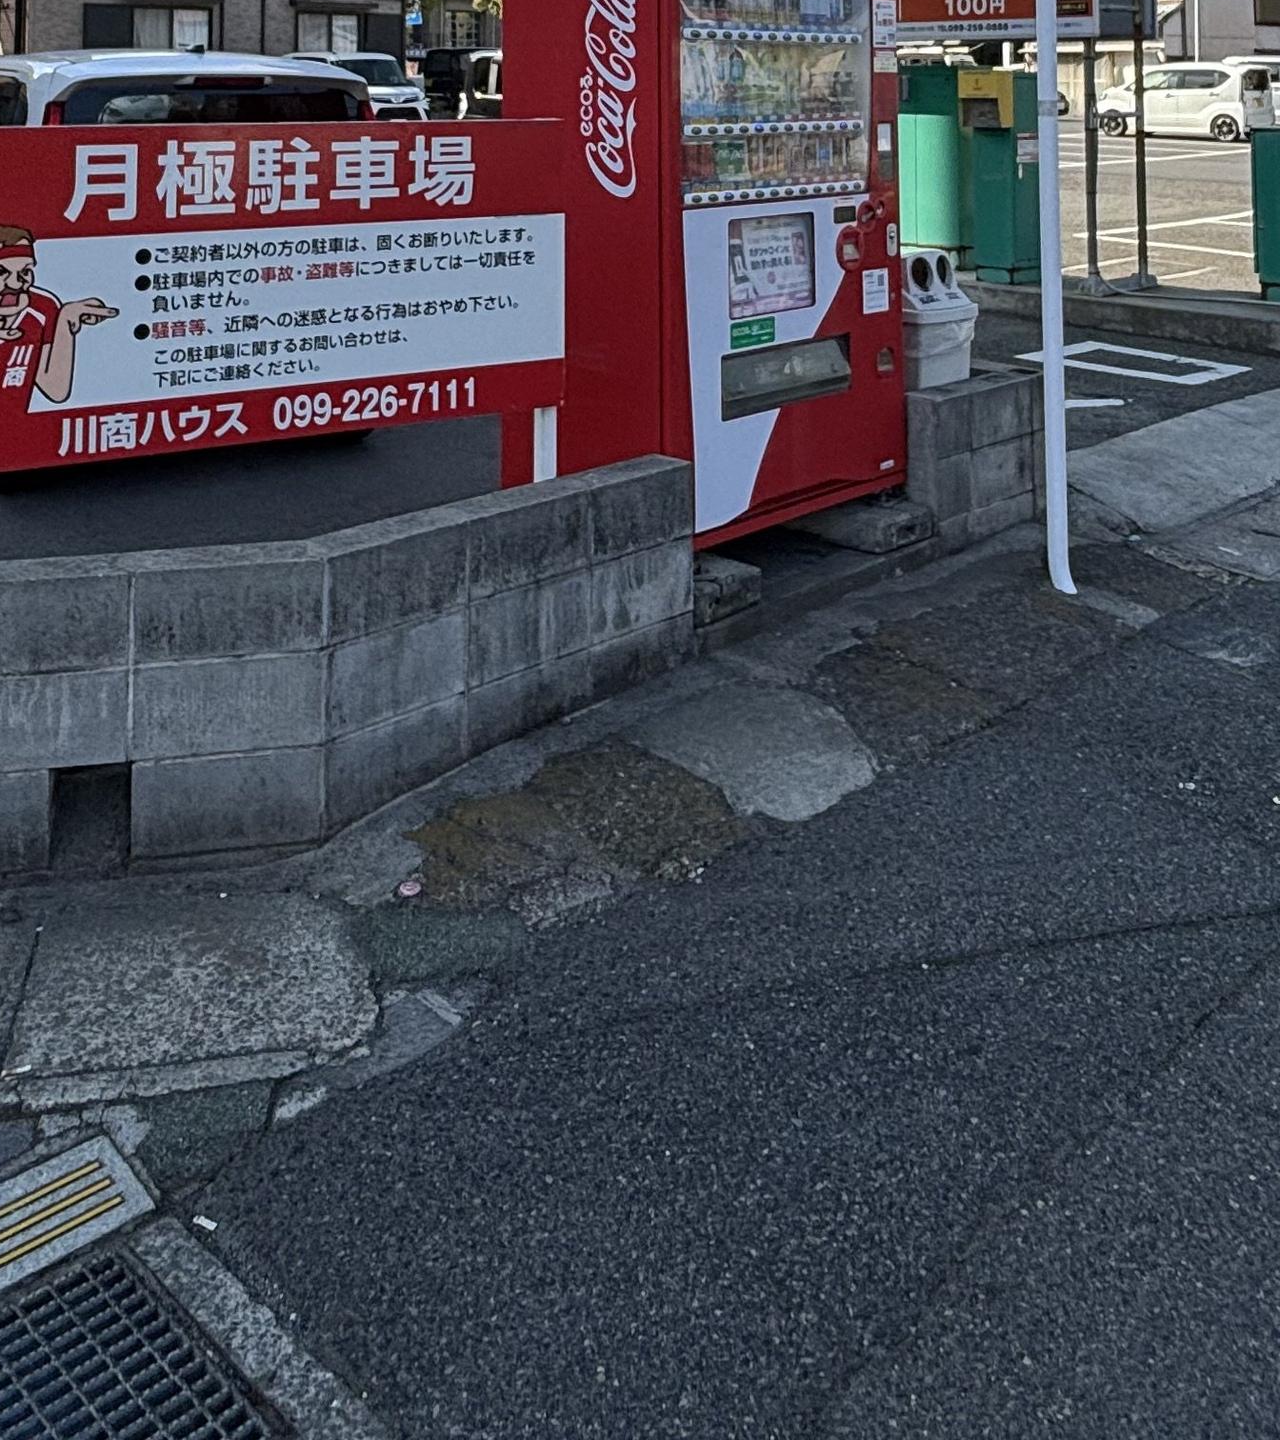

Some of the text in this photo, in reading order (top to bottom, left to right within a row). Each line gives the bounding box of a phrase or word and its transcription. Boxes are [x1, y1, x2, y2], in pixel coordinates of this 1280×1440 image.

[63, 135, 476, 223] 月極駐車場
[154, 227, 534, 264] ご契約者以外の方の駐車は、固くお断りいたします。
[151, 295, 519, 340] 騒音等、近隣への迷惑となる行為はおやめ下さい。
[152, 291, 250, 313] 負いません。
[154, 329, 408, 365] この駐車場に関するお問い合わせは、
[153, 359, 321, 389] 下記にご連絡ください。
[58, 376, 477, 457] 川商ハウス 099-226-7111
